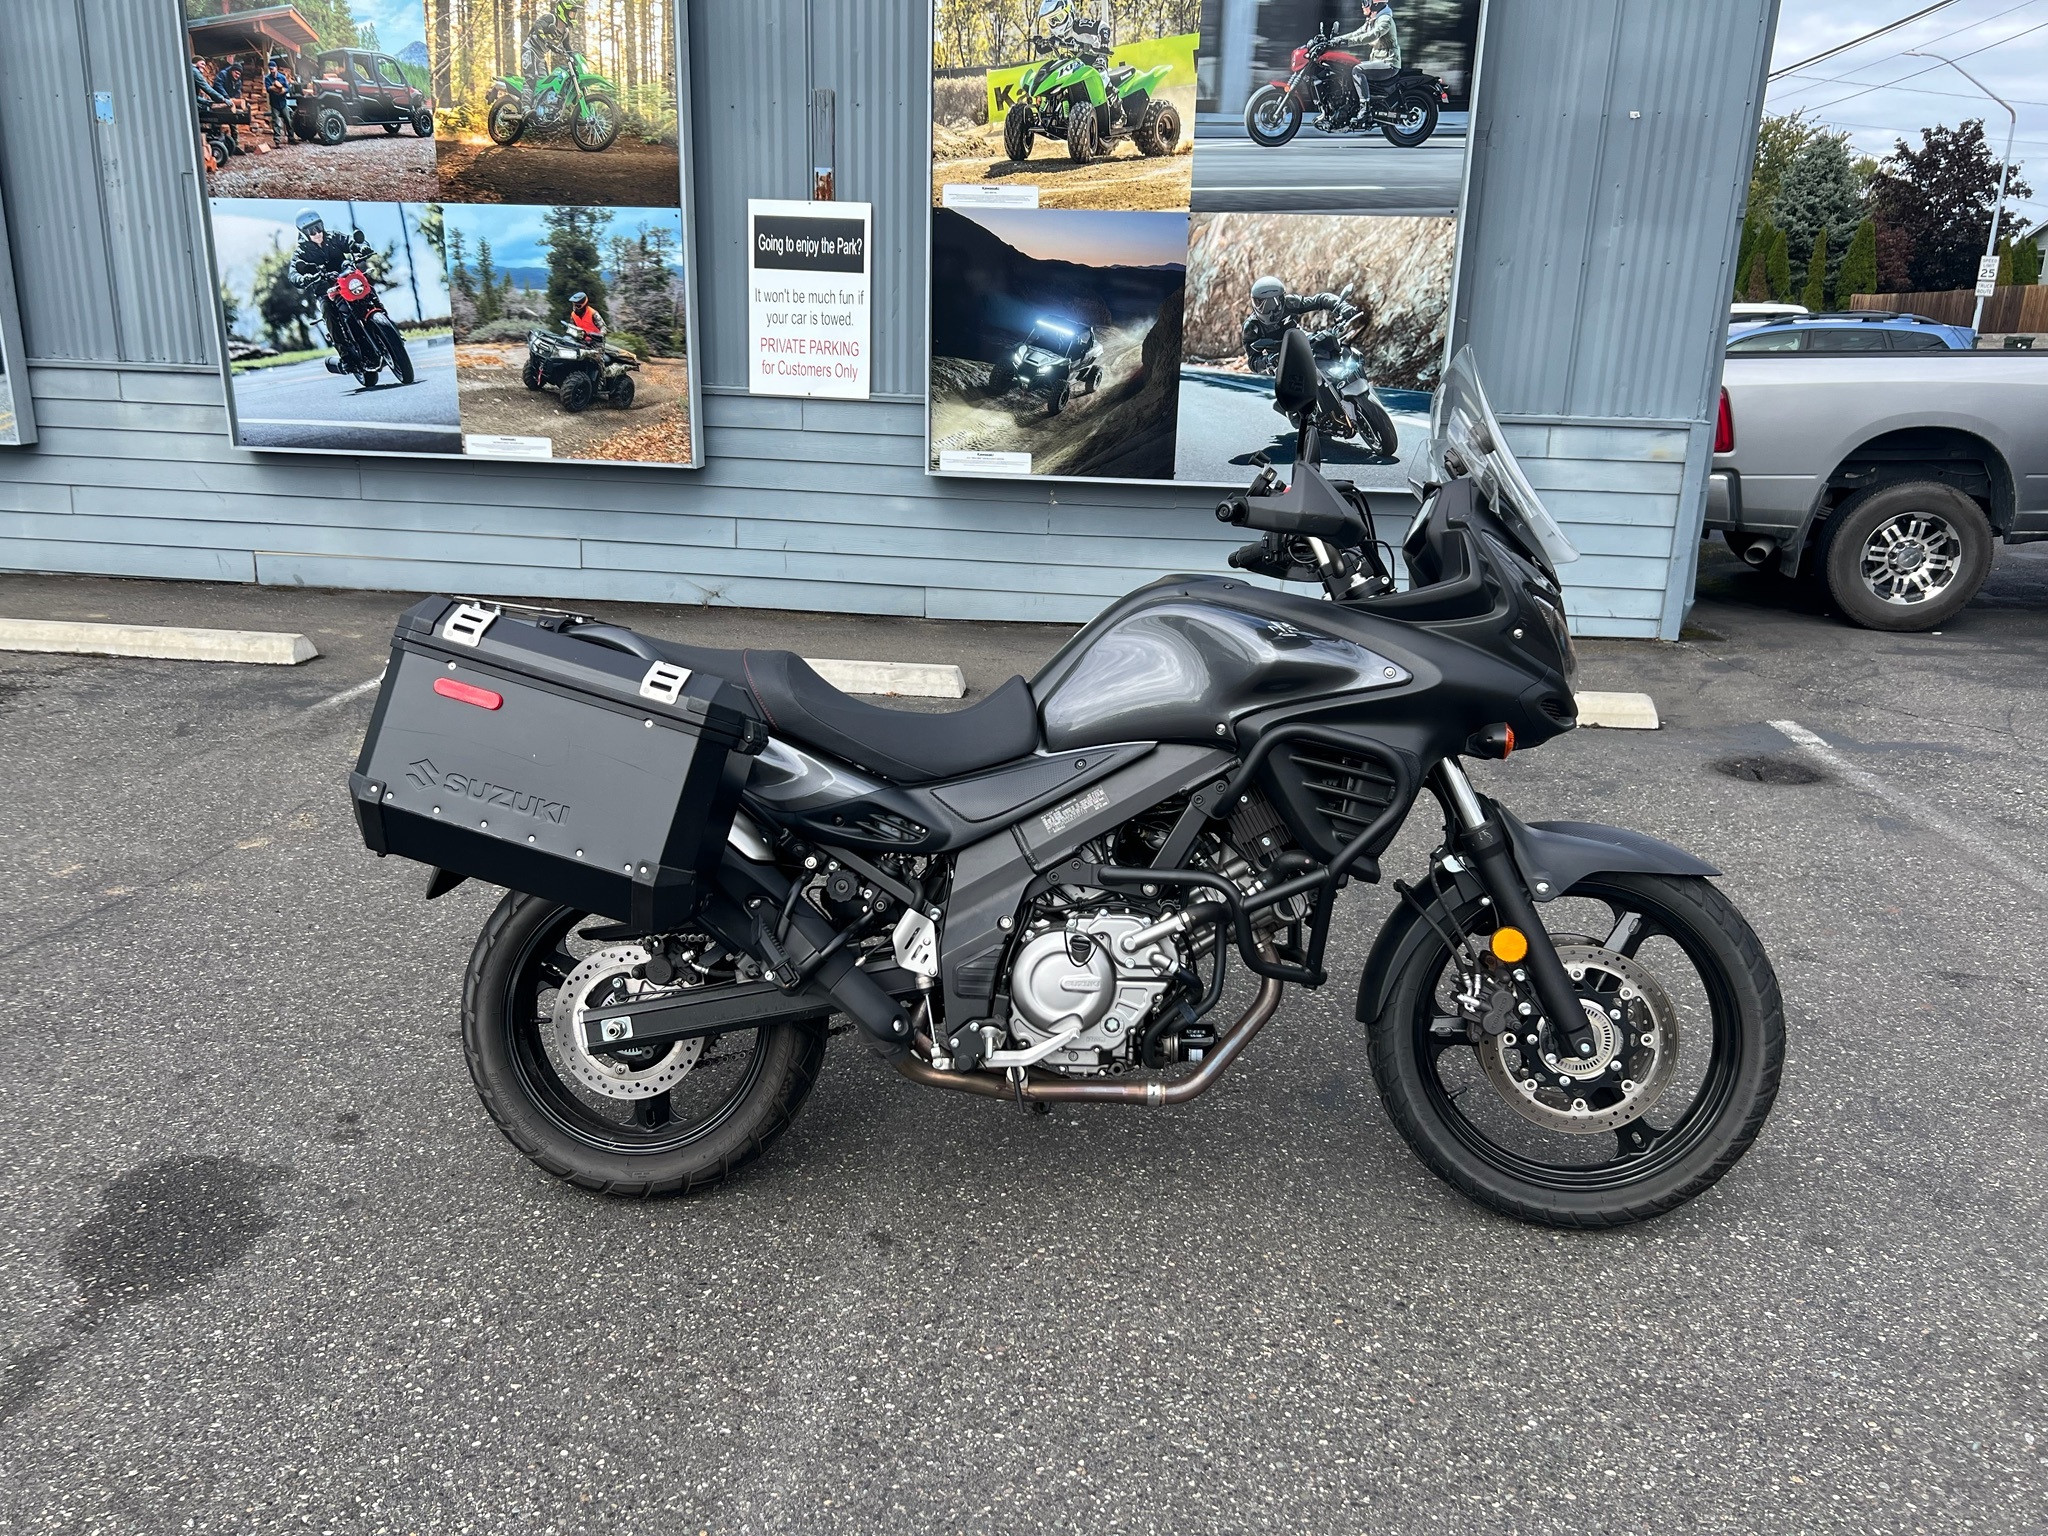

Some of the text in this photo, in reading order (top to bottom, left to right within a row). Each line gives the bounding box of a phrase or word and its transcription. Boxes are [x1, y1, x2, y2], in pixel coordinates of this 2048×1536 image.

[758, 233, 863, 258] Going to enjoy the Park?
[1980, 268, 1995, 277] 25
[755, 288, 865, 305] It won't be much fun if
[766, 311, 854, 328] your car is towed.
[760, 337, 860, 357] PRIVATE PARKING
[762, 360, 859, 383] for Customers Only
[443, 772, 571, 827] SUZUKI
